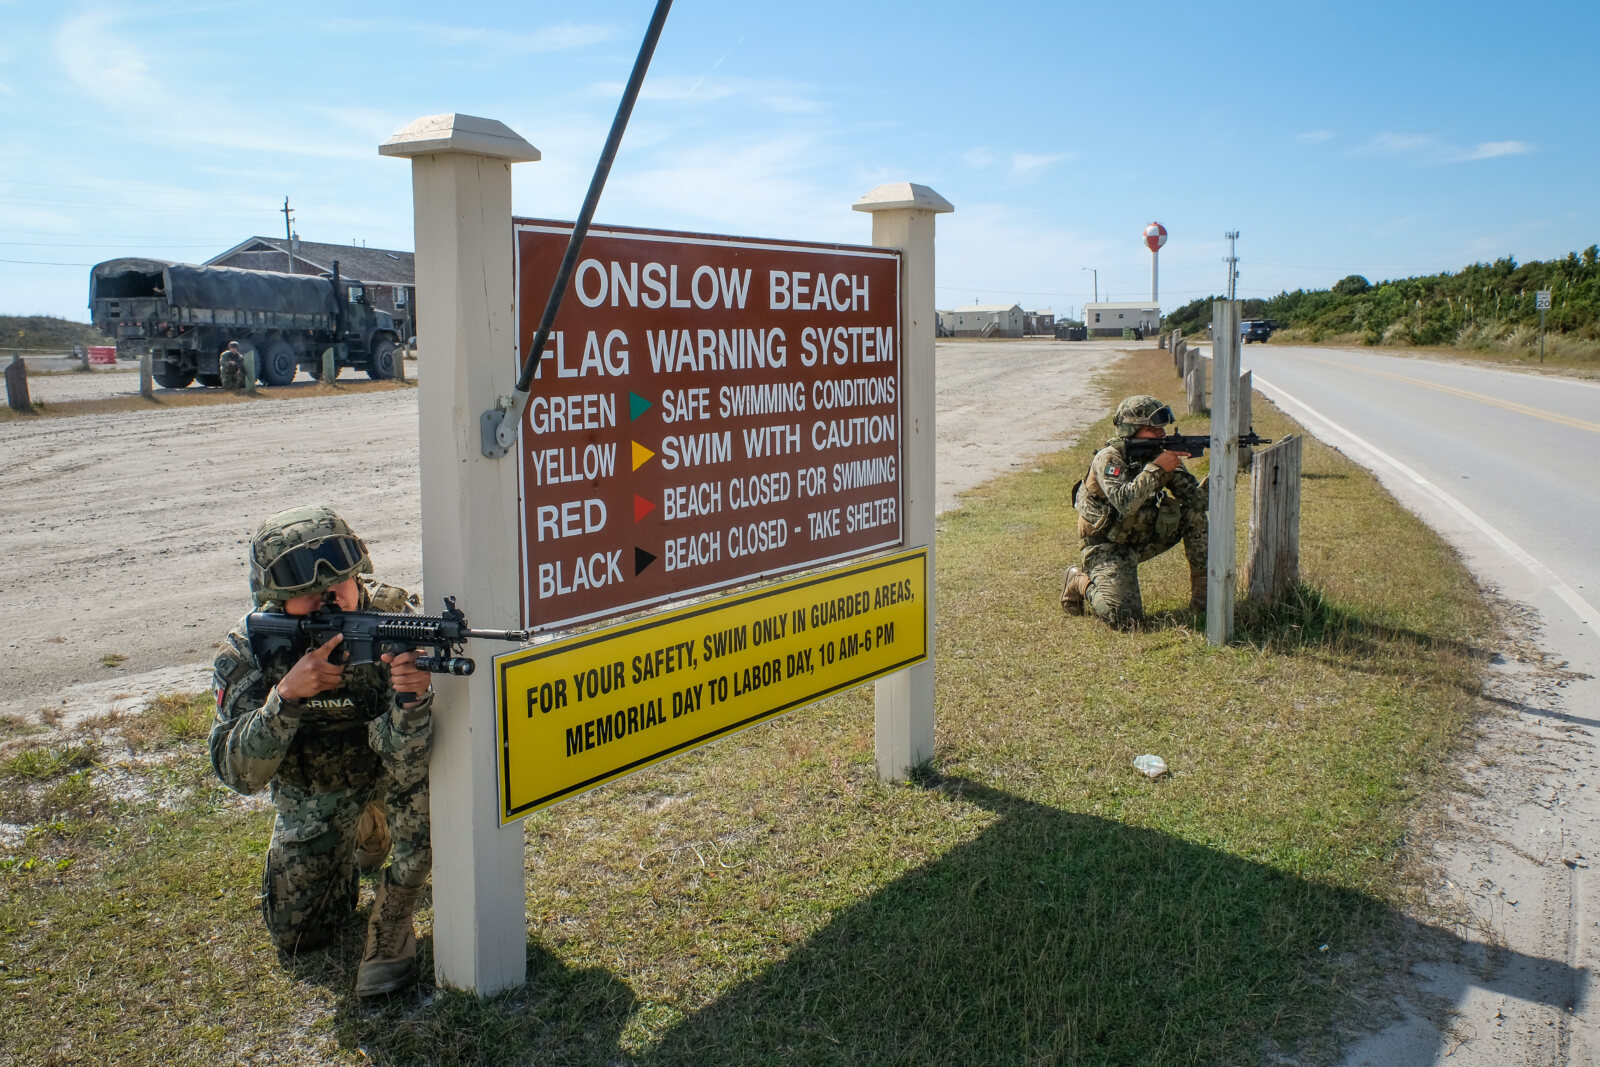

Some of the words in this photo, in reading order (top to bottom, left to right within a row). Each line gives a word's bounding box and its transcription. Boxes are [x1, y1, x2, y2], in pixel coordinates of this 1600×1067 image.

[575, 259, 752, 309] ONSLOW
[770, 270, 869, 311] BEACH
[1537, 300, 1550, 308] 20
[646, 328, 787, 374] WARNING
[801, 327, 894, 366] SYSTEM
[530, 393, 616, 434] GREEN
[662, 388, 711, 423] SAFE
[720, 382, 805, 418] SWIMMING
[813, 376, 895, 410] CONDITIONS
[532, 443, 617, 486] YELLOW
[662, 431, 732, 470] SWIM
[743, 424, 800, 459] WITH
[812, 415, 895, 450] CAUTION
[664, 482, 721, 521] BEACH
[729, 472, 791, 509] CLOSED
[798, 467, 827, 498] FOR
[833, 455, 896, 492] SWIMMING
[537, 499, 607, 542] RED
[665, 531, 721, 572] BEACH
[728, 518, 787, 558] CLOSED
[808, 508, 841, 541] TAKE
[847, 497, 896, 533] SHELTER
[539, 550, 624, 599] BLACK
[527, 679, 567, 718] FOR
[574, 662, 626, 702] YOUR
[632, 640, 698, 685] SAFETY,
[703, 624, 747, 662] SWIM
[753, 613, 787, 647] ONLY
[793, 607, 806, 634] IN
[811, 590, 870, 629] GUARDED
[874, 579, 915, 610] AREAS,
[566, 698, 667, 758] MEMORIAL
[673, 682, 703, 719] DAY
[708, 675, 728, 705] TO
[734, 658, 781, 697] LABOR
[787, 648, 814, 680] DAY,
[819, 642, 835, 667] 10
[839, 630, 872, 660] AM-6
[876, 622, 895, 648] PM
